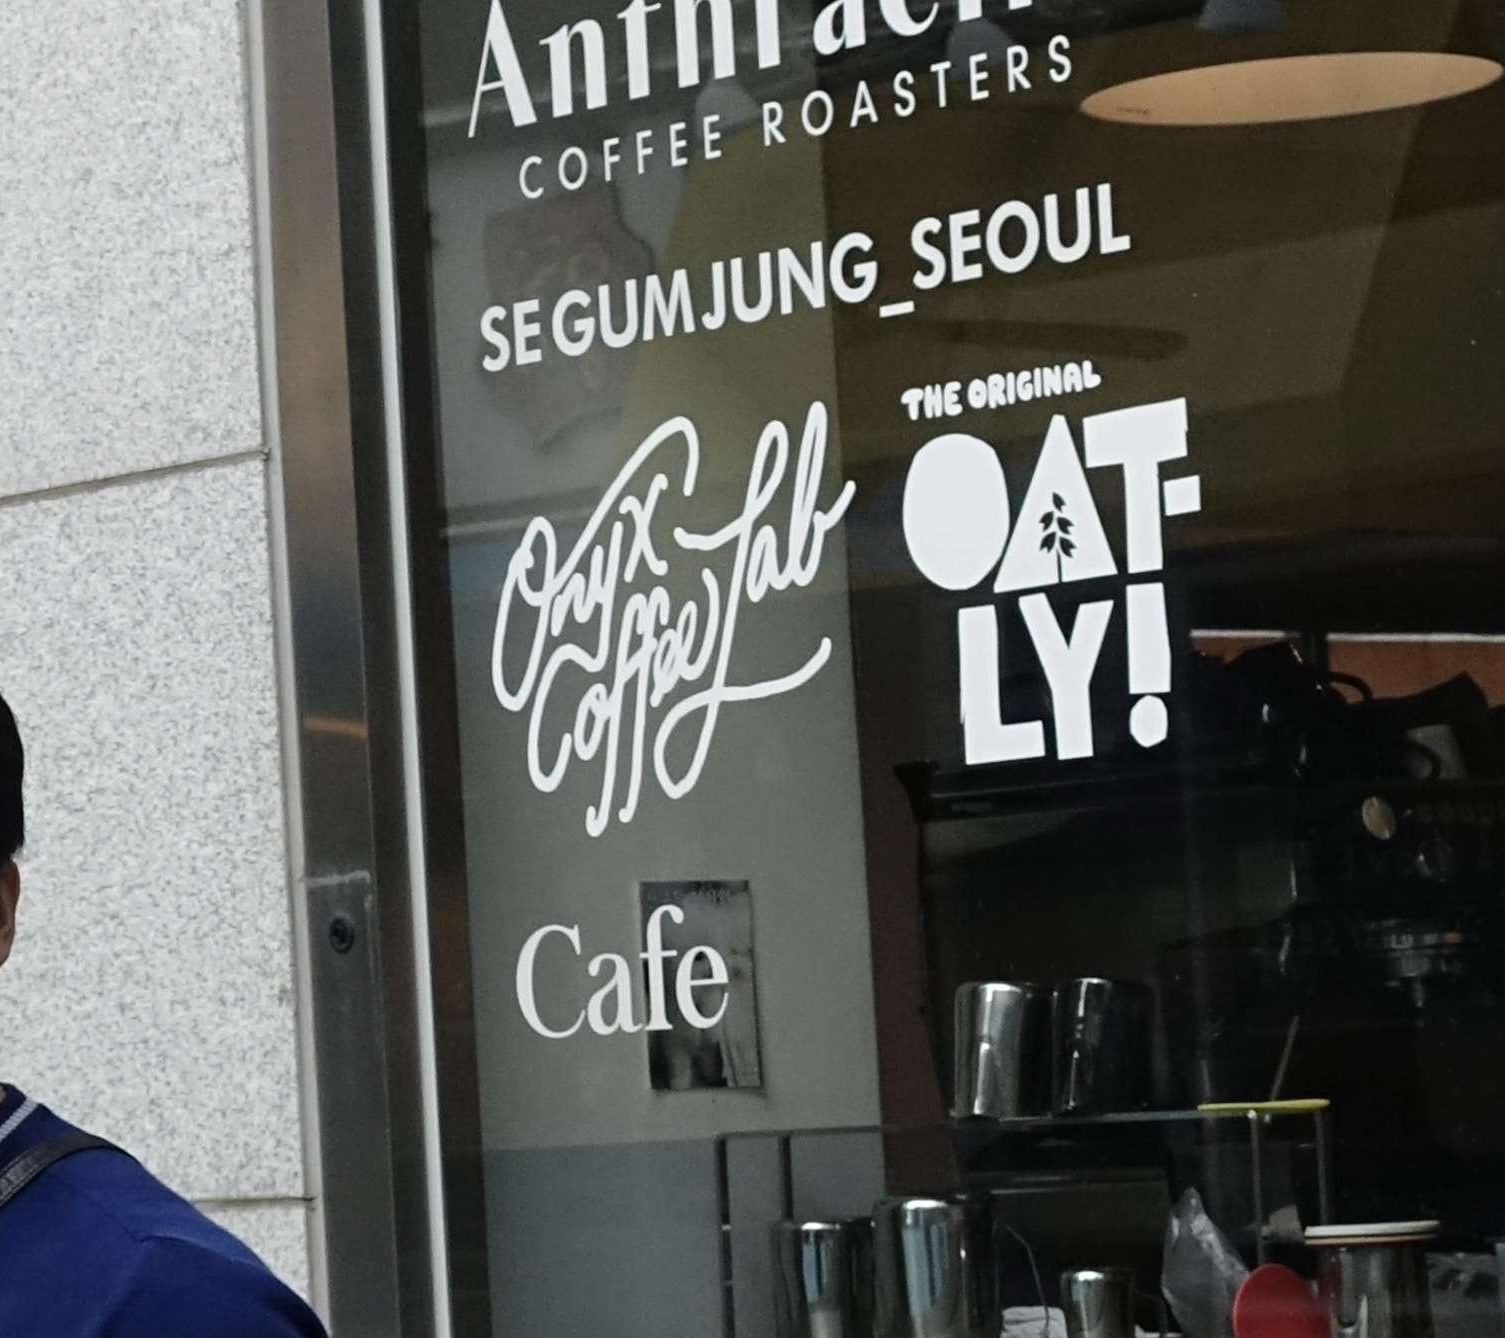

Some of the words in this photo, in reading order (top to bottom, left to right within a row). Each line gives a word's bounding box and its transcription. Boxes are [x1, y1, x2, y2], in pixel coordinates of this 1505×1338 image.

[468, 0, 1032, 138] Anthra
[519, 114, 722, 199] COFFEE
[762, 35, 1072, 147] ROASTERS
[900, 373, 963, 421] THE
[967, 360, 1102, 409] ORIGINAL
[491, 415, 700, 712] Onyx
[527, 567, 721, 838] Coffee
[653, 400, 857, 800] Lab
[958, 582, 1171, 765] LY!
[515, 904, 729, 1039] Cafe
